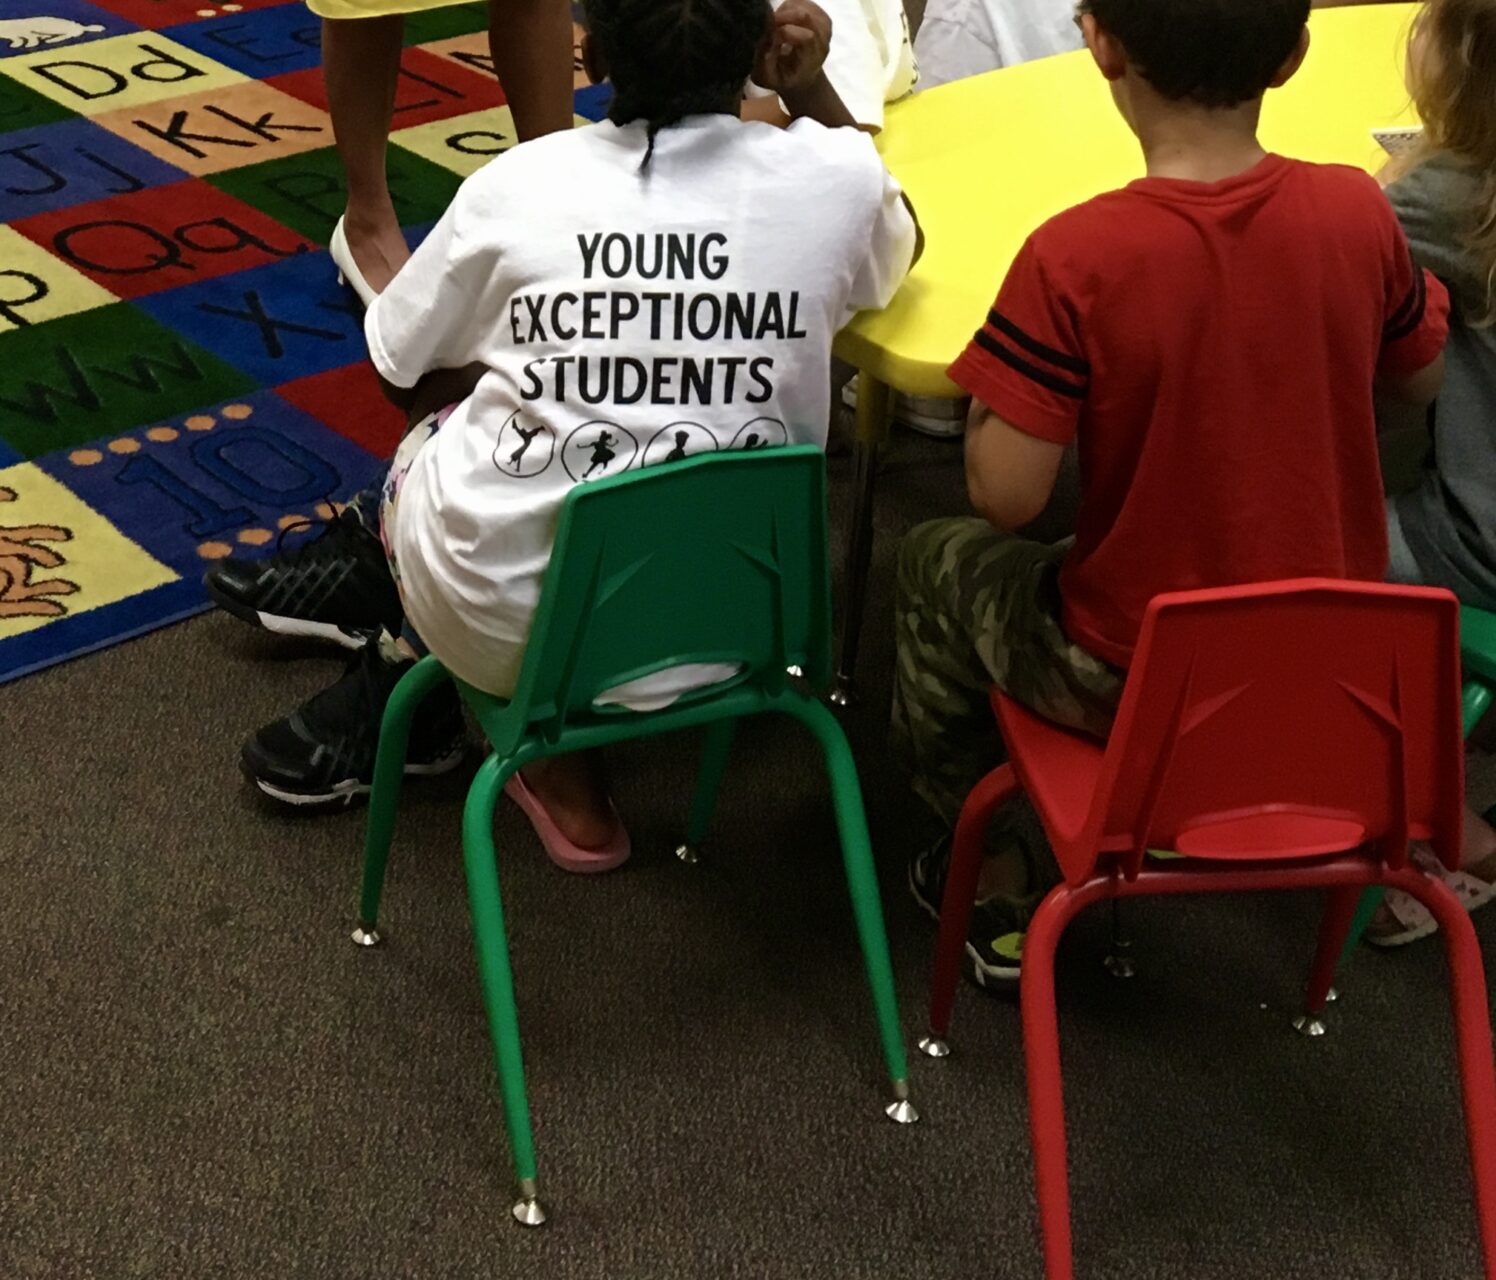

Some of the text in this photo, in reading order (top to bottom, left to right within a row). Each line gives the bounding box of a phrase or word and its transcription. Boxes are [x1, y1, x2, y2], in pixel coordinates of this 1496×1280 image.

[30, 45, 207, 99] Dd
[131, 104, 323, 159] Kk
[54, 218, 309, 273] Qq
[577, 232, 729, 280] YOUNG
[510, 291, 806, 344] EXCEPTIONAL
[519, 356, 775, 405] STUDENTS
[115, 426, 342, 539] 10
